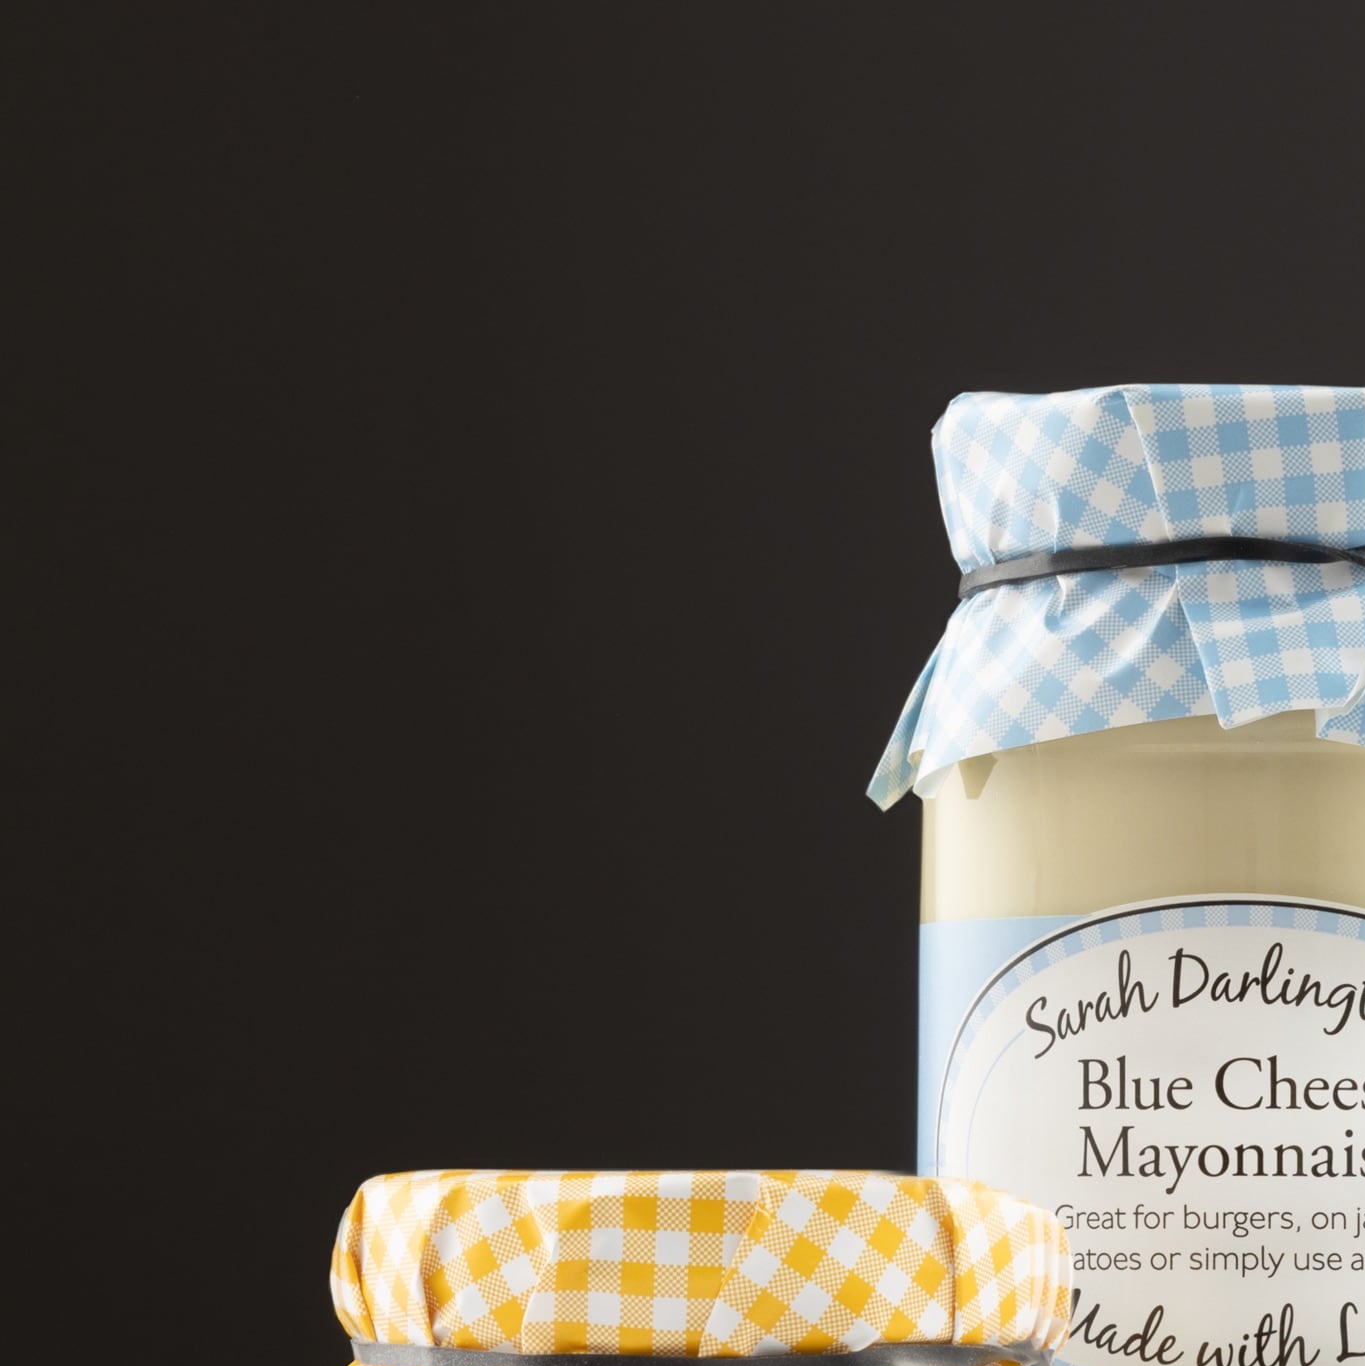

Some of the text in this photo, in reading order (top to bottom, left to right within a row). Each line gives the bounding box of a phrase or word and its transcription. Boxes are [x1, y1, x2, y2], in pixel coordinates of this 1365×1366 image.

[1025, 949, 1160, 1060] Sarah
[1077, 1055, 1193, 1111] Blue
[1054, 1204, 1127, 1230] Great
[1132, 1203, 1175, 1230] for
[1183, 1203, 1301, 1239] burgers,
[1311, 1211, 1347, 1230] on
[1073, 1248, 1142, 1271] atoes
[1150, 1252, 1182, 1271] or
[1189, 1244, 1285, 1279] simply
[1293, 1252, 1343, 1271] use
